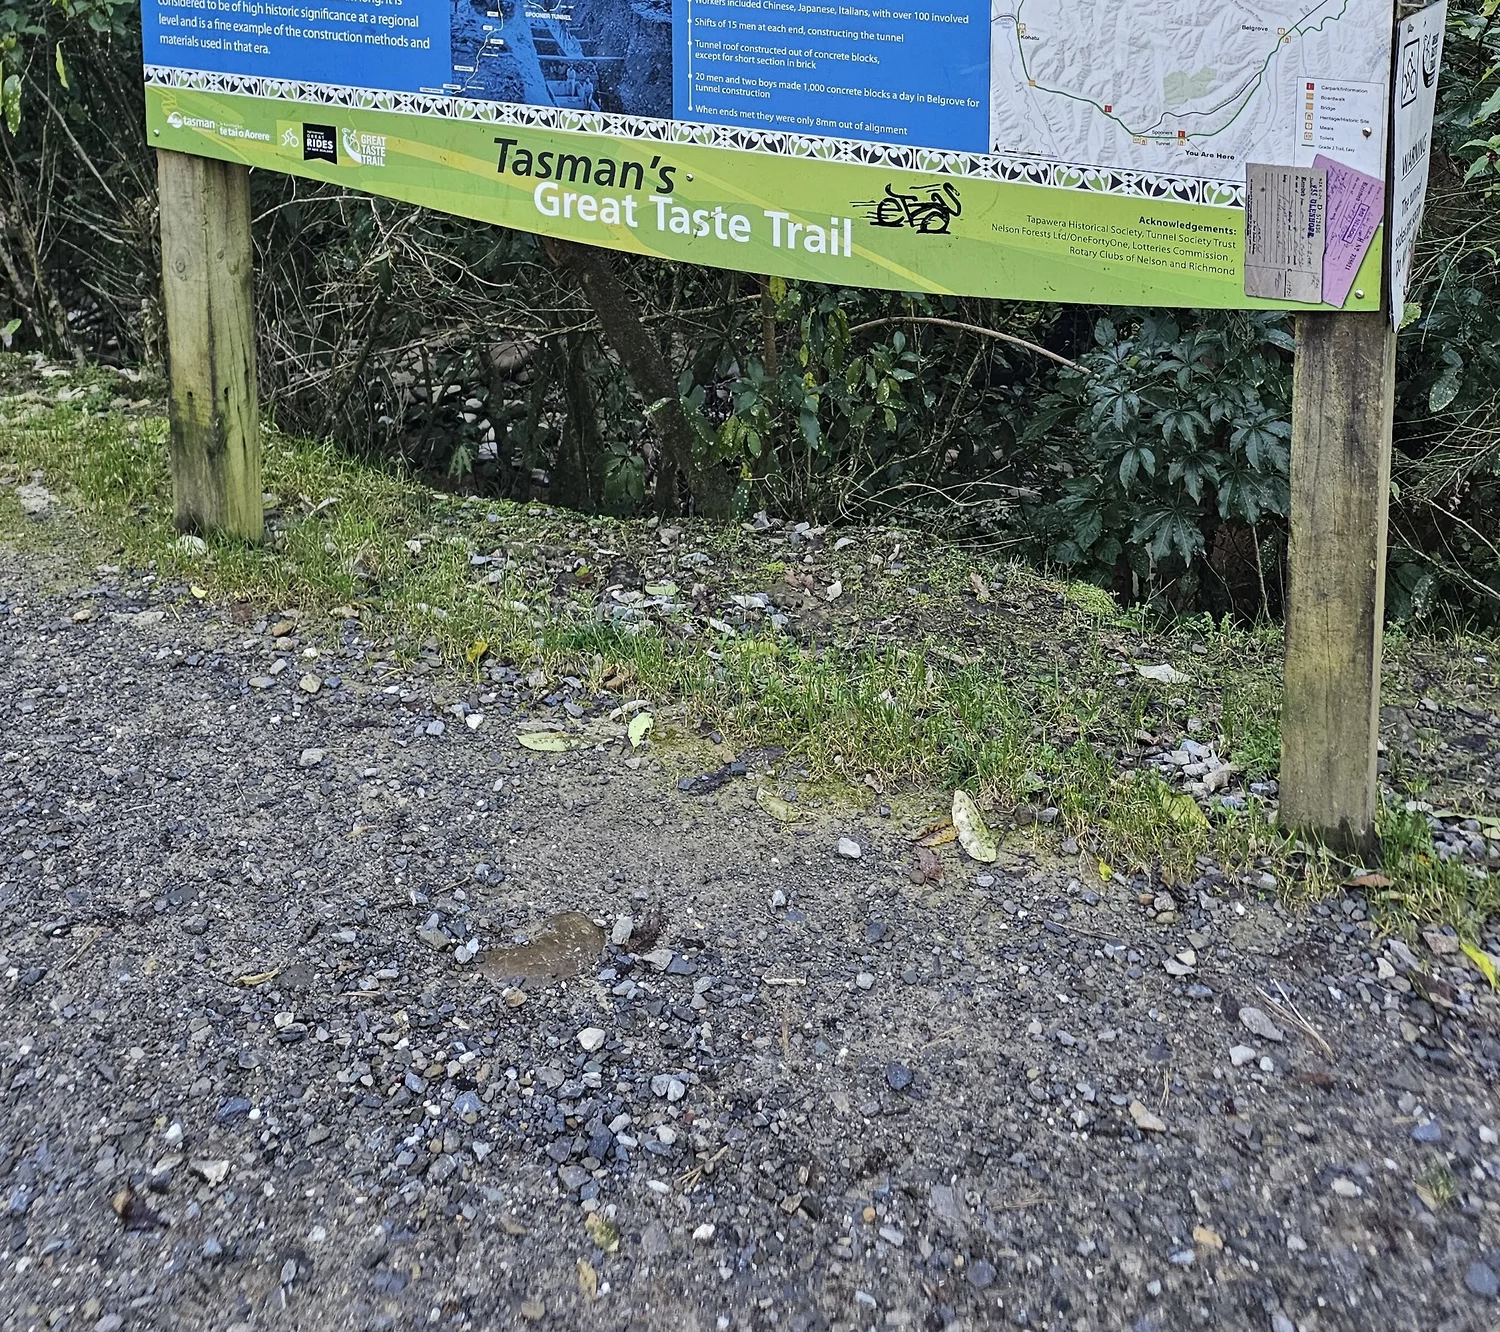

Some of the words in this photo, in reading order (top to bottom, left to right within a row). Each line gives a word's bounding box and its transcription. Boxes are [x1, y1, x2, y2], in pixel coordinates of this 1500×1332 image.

[183, 116, 215, 128] tasman
[244, 129, 270, 141] Aorere
[361, 134, 386, 147] GREAT
[306, 138, 334, 150] RIDES
[361, 145, 386, 157] TASTE
[362, 154, 386, 167] TRAIL
[493, 137, 676, 194] Tasman's
[533, 181, 637, 227] Great
[648, 193, 750, 242] Taste
[763, 209, 851, 257] Trail
[1138, 216, 1236, 235] Acknowledgements:
[1026, 215, 1066, 229] Tapawera
[1068, 220, 1108, 232] Historical
[1110, 225, 1144, 238] Society,
[1145, 229, 1176, 241] Tunnel
[1178, 233, 1211, 247] Society
[1213, 237, 1235, 248] Trust
[991, 223, 1019, 233] Nelson
[1021, 226, 1050, 238] Forests
[1053, 231, 1130, 249] Ltd/OneFortyOne,
[1132, 241, 1170, 253] Lotteries
[1172, 246, 1228, 261] Commission
[1069, 246, 1097, 258] Rotary
[1099, 250, 1123, 260] Clubs
[1125, 253, 1135, 261] of
[1136, 254, 1167, 266] Nelson
[1169, 260, 1186, 268] and
[1189, 261, 1234, 275] Richmond
